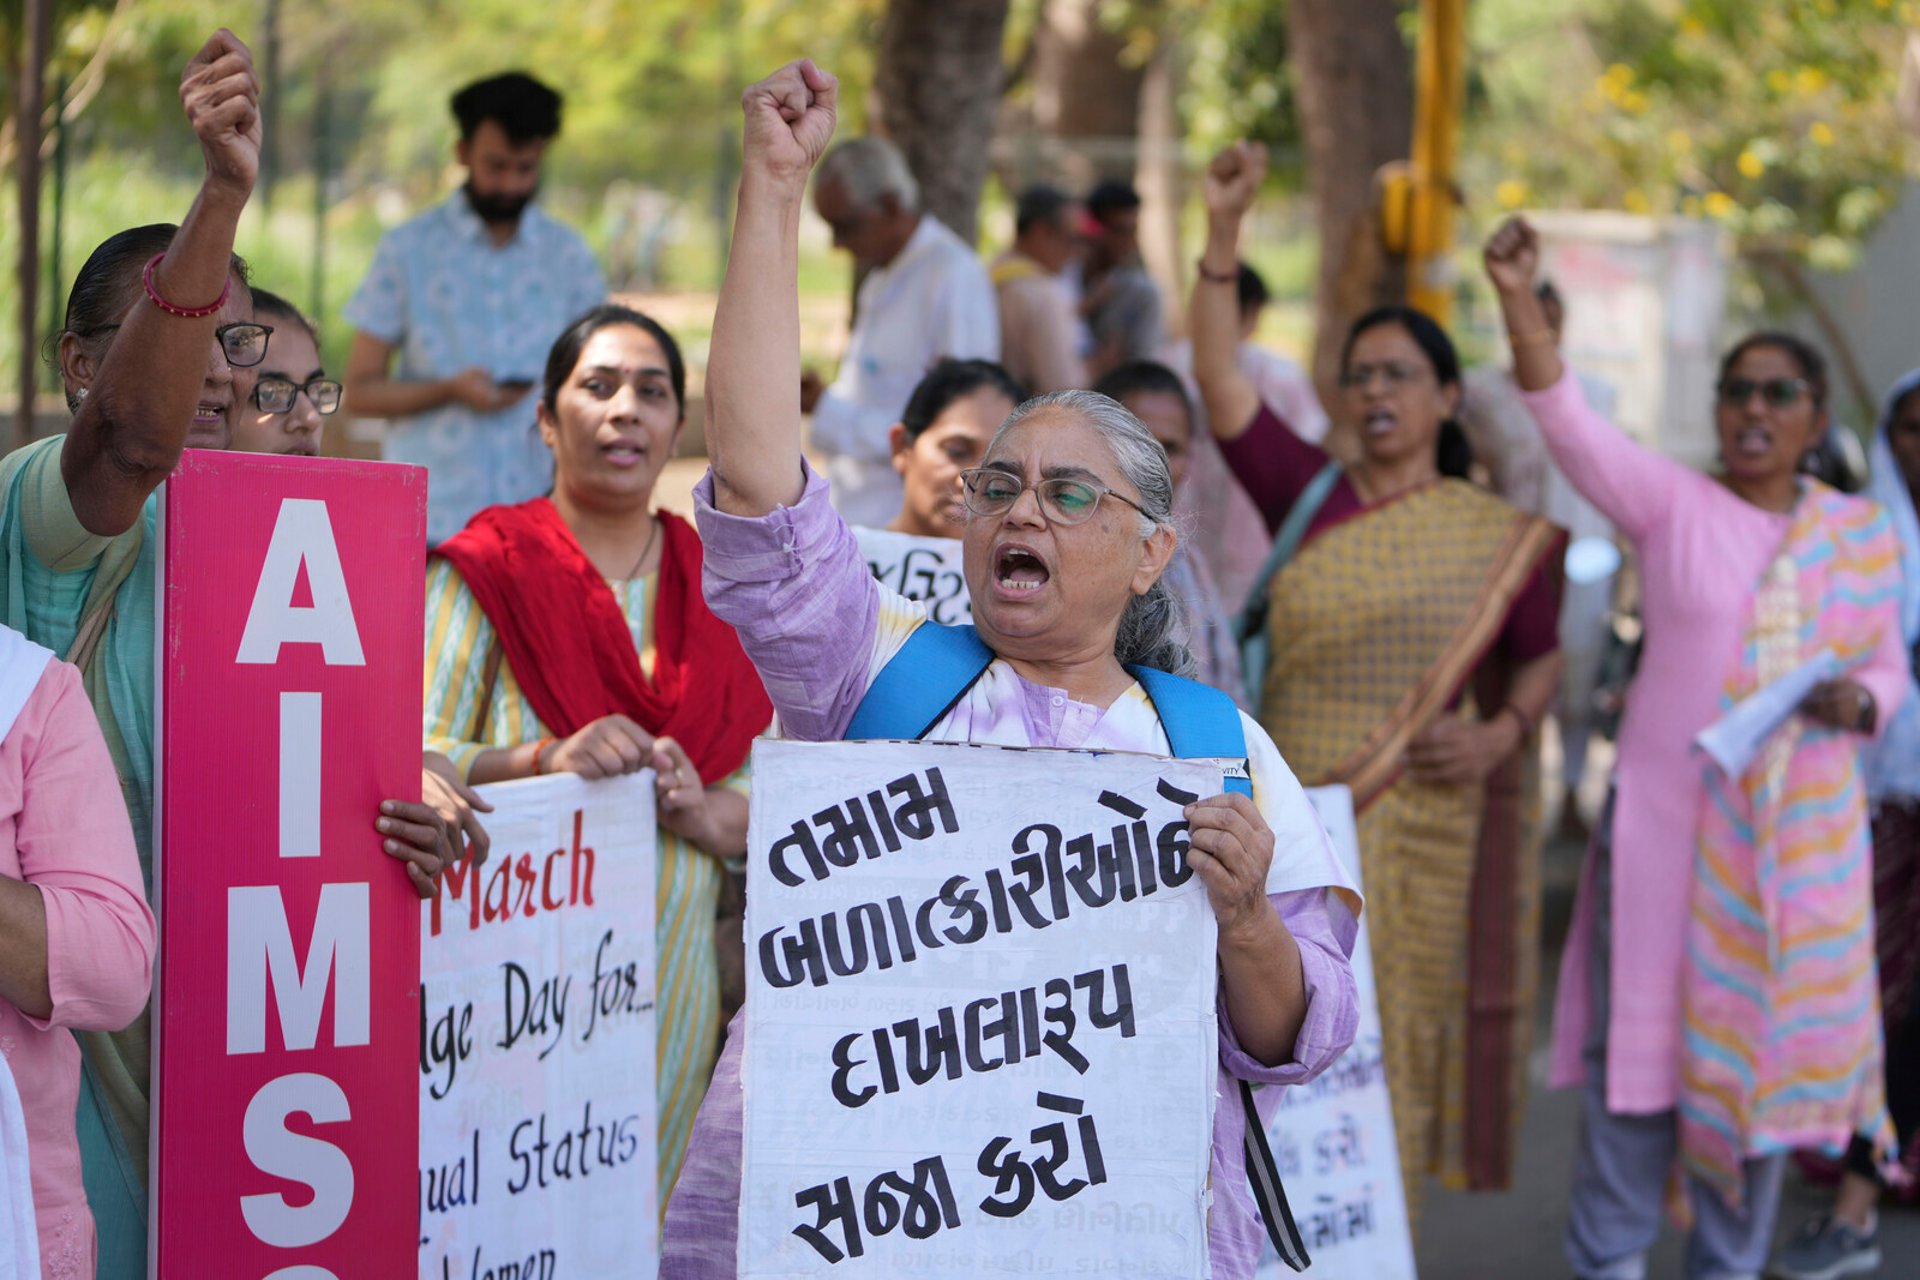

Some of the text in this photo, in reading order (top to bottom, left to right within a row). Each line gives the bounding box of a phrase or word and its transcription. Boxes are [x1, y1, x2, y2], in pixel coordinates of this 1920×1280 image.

[226, 498, 371, 1280] AIMS
[431, 808, 595, 937] March
[768, 766, 960, 887] તમામ
[497, 962, 572, 1061] Day
[831, 963, 1136, 1108] દાખલારૂપ
[419, 1101, 640, 1246] ual Status
[792, 1090, 1107, 1264] સજા કરો
